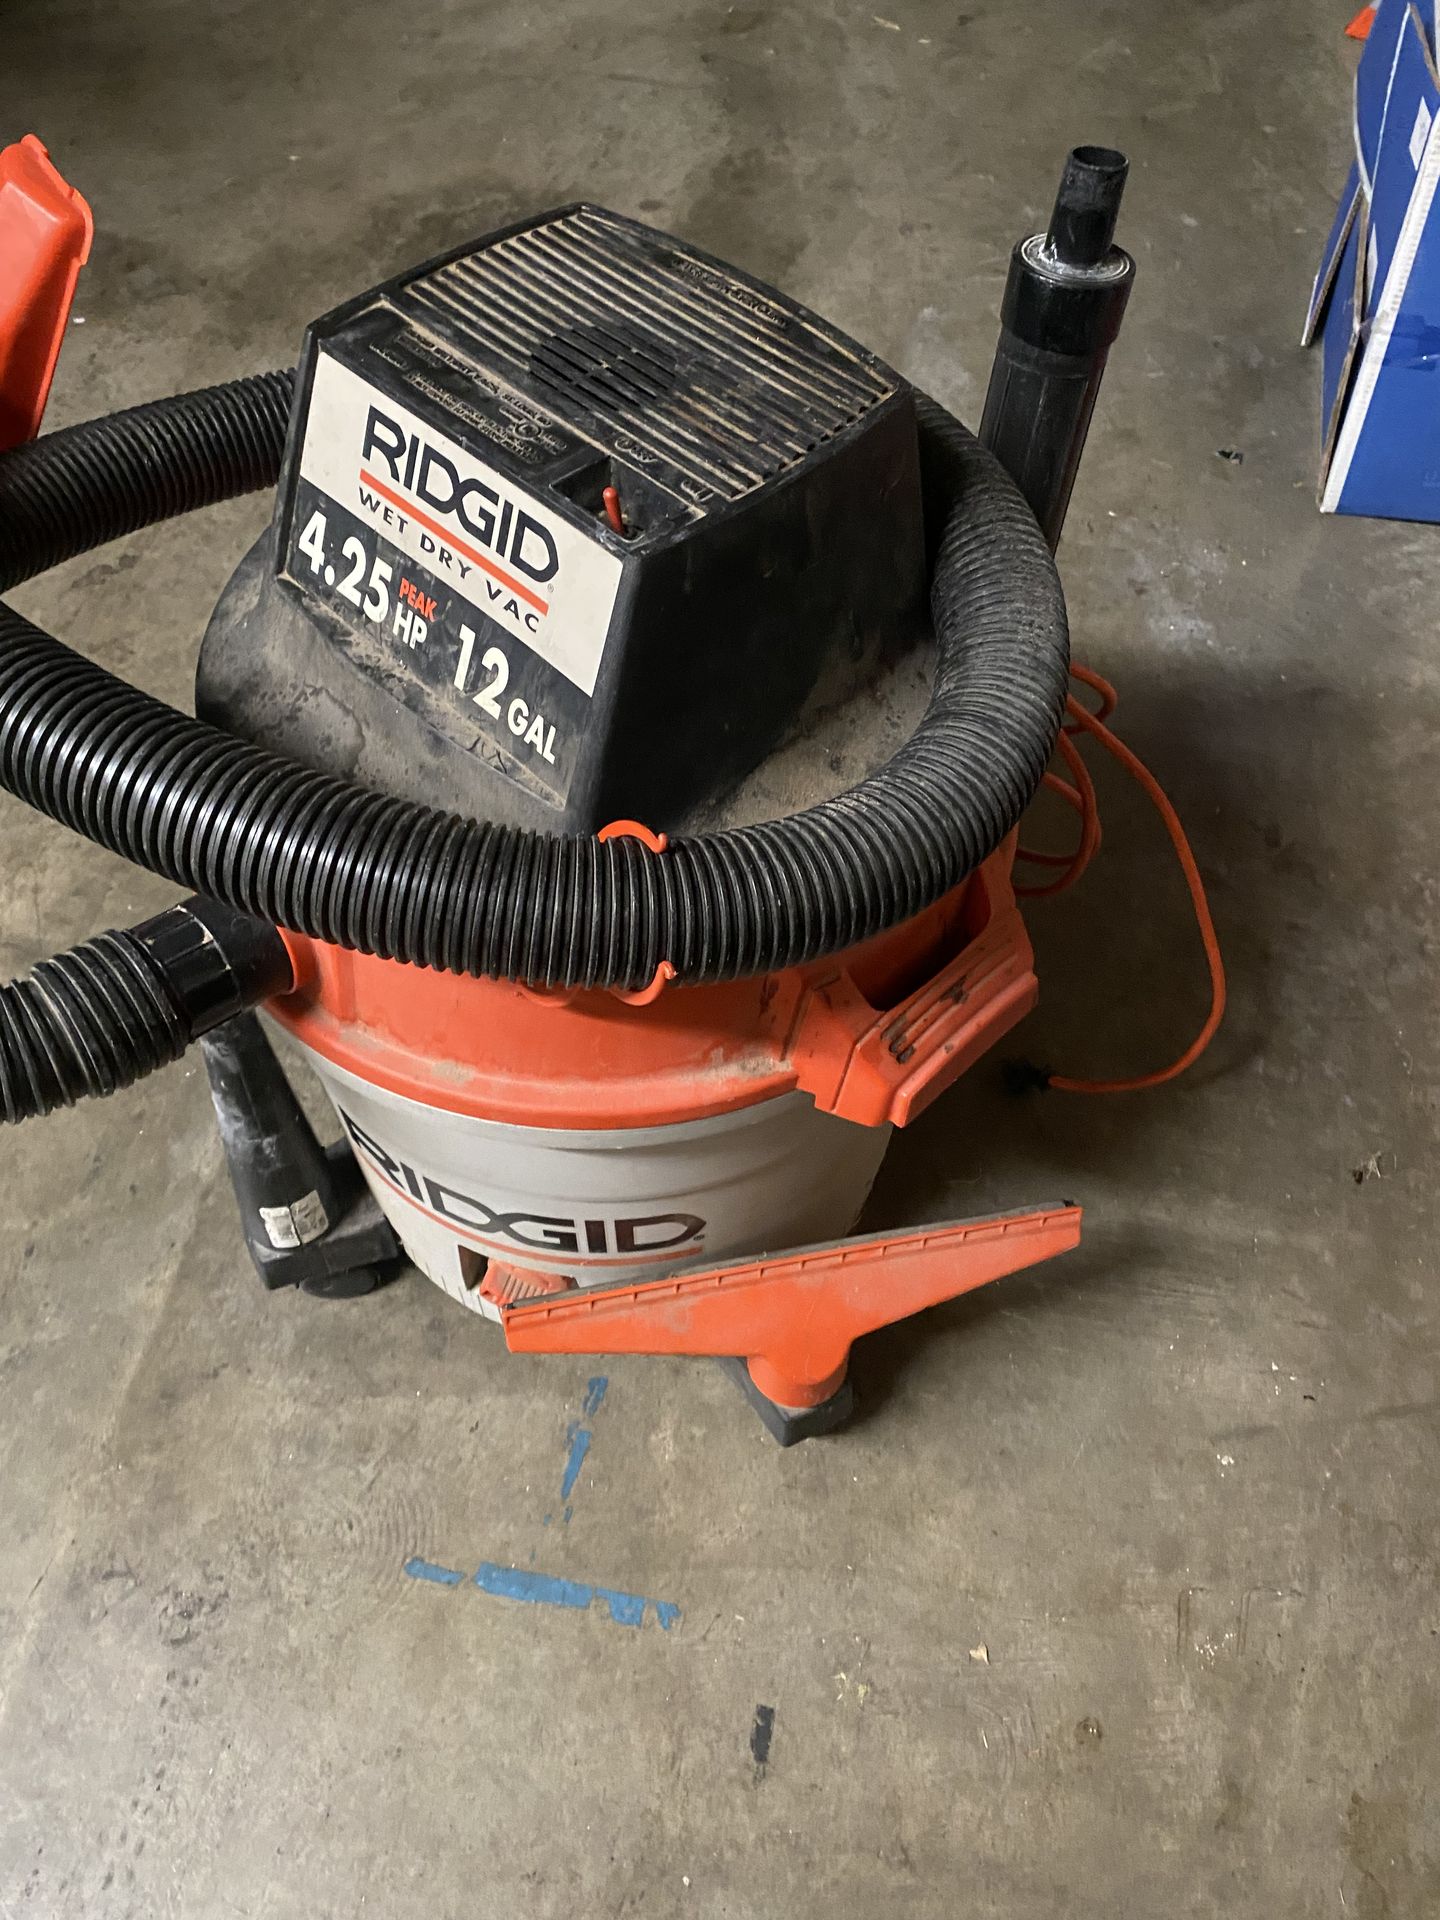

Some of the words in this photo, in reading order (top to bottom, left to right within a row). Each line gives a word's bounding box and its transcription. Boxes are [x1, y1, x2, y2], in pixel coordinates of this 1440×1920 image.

[362, 404, 560, 583] RIDGID
[298, 510, 393, 623] 4.25
[359, 486, 408, 534] WET
[420, 533, 472, 580] DRY
[486, 580, 540, 634] VAC
[399, 577, 438, 623] PEAK
[392, 602, 428, 650] HP
[454, 623, 510, 721] 12
[507, 698, 557, 765] GAL
[339, 1104, 707, 1253] RIDGID
